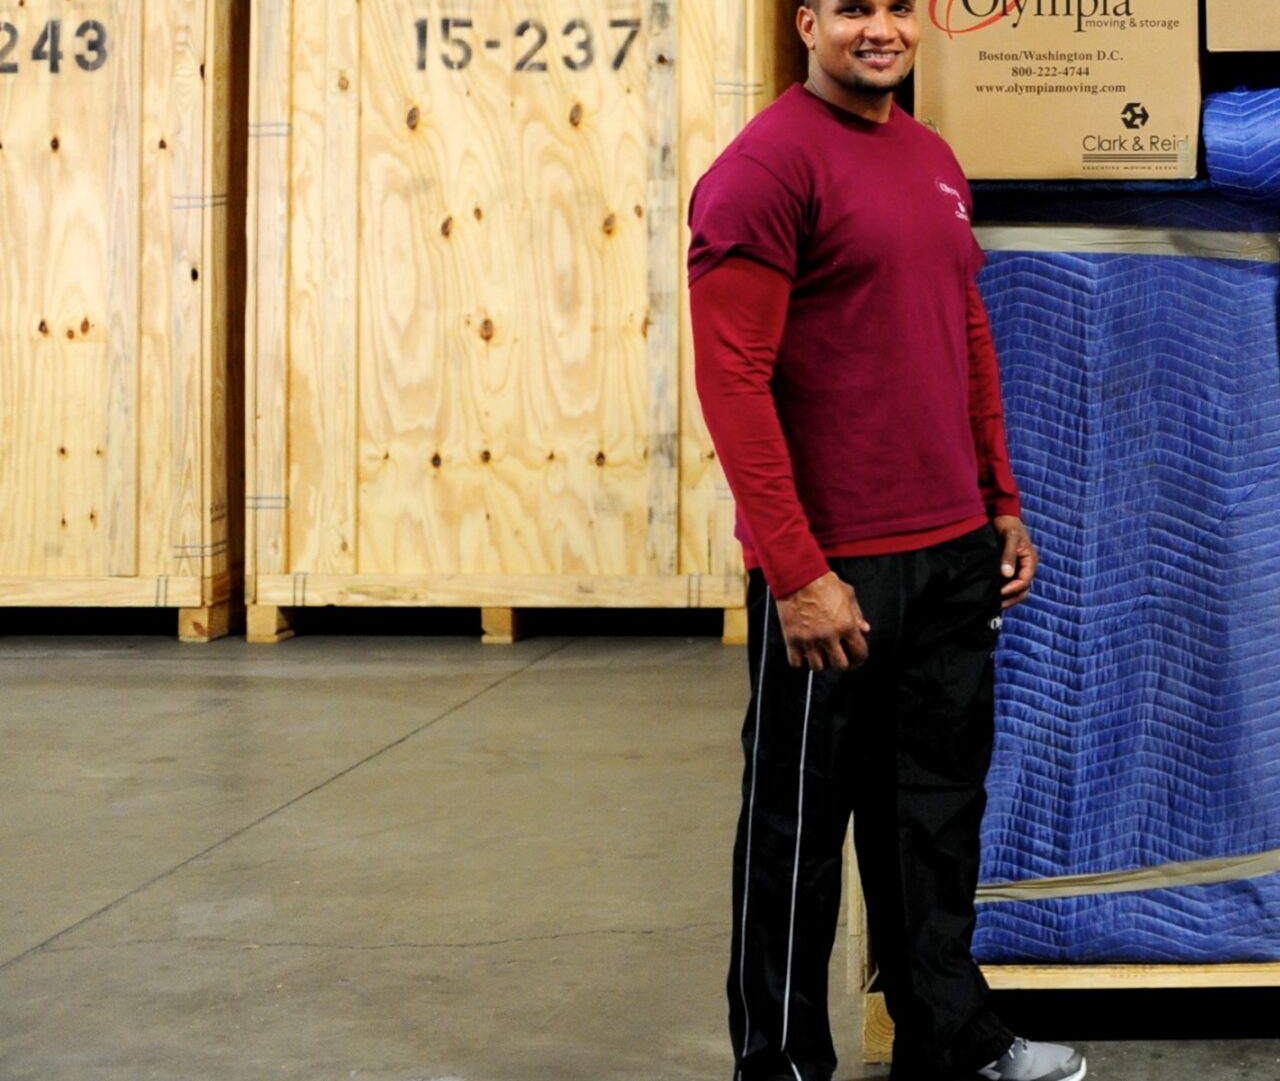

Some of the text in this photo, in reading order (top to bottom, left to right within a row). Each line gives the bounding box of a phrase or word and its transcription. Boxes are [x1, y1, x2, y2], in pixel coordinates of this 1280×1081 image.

[1085, 17, 1180, 30] moving & storage
[415, 18, 641, 72] 15-237
[978, 50, 1124, 63] Boston/Washington D.C.
[1011, 66, 1090, 77] 800-222-4744
[975, 82, 1126, 95] www.olympiamoving.com
[1082, 134, 1128, 152] Clark
[1132, 135, 1145, 152] &
